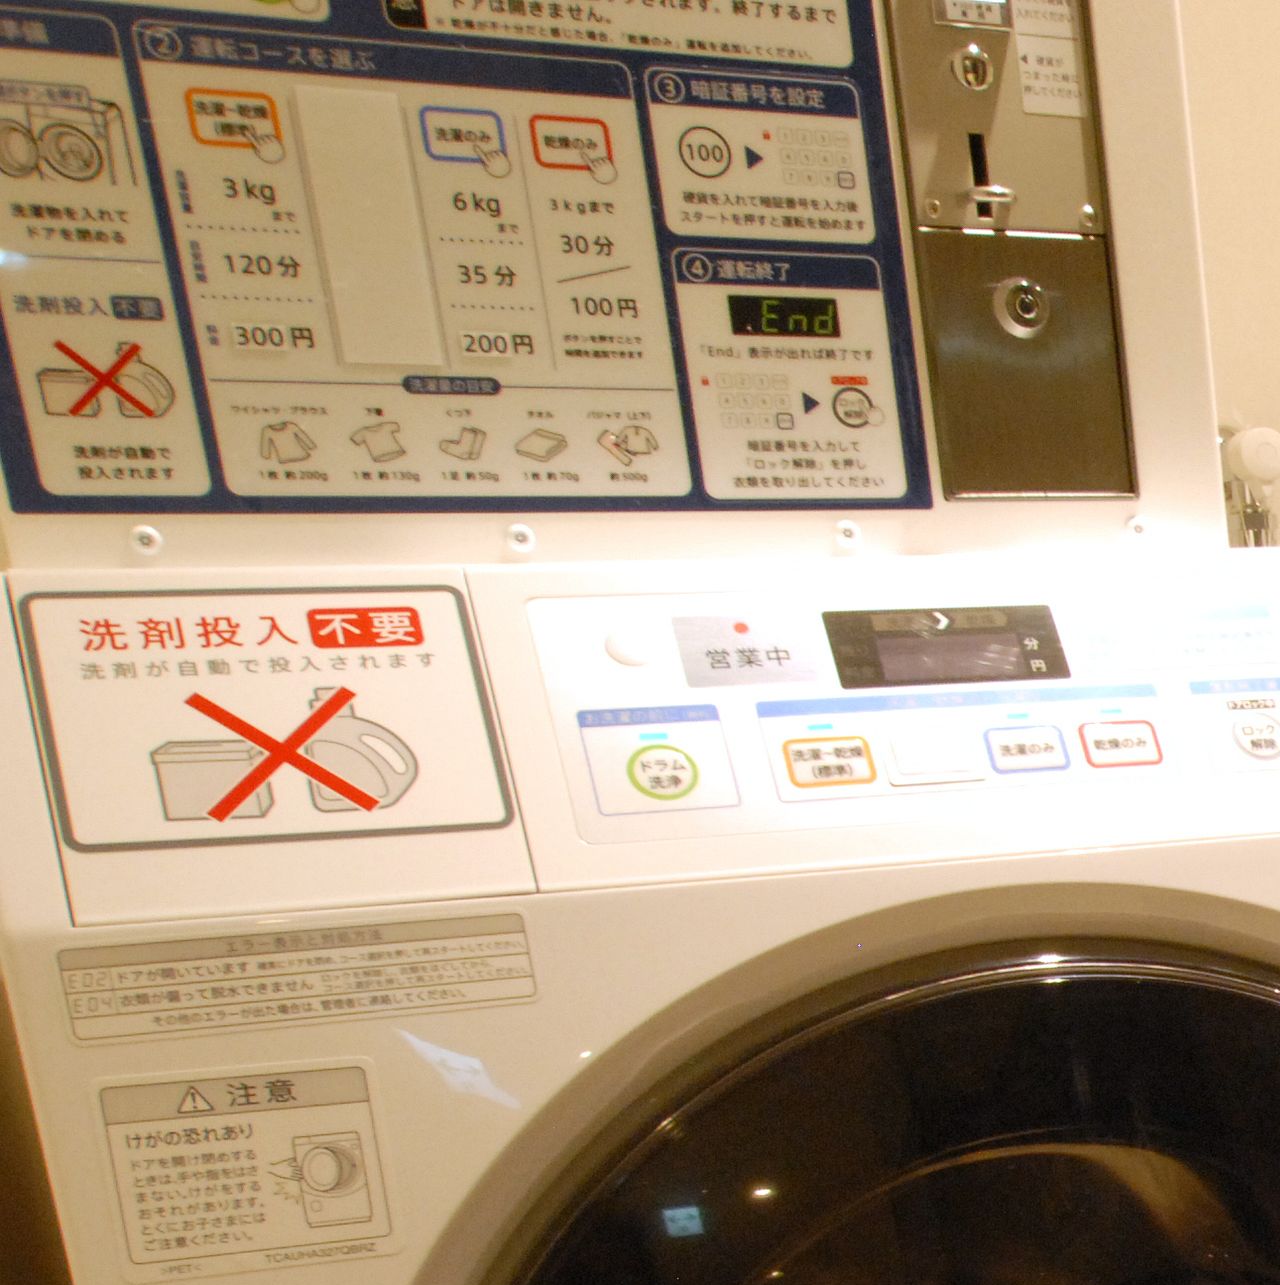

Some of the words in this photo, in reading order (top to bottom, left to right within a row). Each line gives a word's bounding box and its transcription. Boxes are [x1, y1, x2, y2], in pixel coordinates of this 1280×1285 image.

[191, 36, 376, 72] 運転コースを選ぶ
[690, 80, 826, 109] 暗証番号を設定
[434, 127, 492, 144] 洗濯のみ
[686, 144, 724, 163] 100
[11, 203, 129, 223] 洗濯物を入れて
[26, 226, 126, 244] ドアを閉める
[717, 260, 790, 281] 運転終了
[761, 300, 836, 335] End
[73, 446, 171, 460] 洗剤が自動で
[78, 466, 174, 480] 投入されます
[79, 616, 299, 652] 洗剤投入
[318, 611, 417, 645] 不要
[80, 652, 436, 680] 洗剤が自動で投入されます
[705, 646, 791, 670] 営業中
[640, 759, 687, 773] ドラム
[226, 1080, 298, 1108] 注意
[126, 1124, 254, 1149] けがの恐れあり
[130, 1150, 257, 1171] ドアを開け閉めする
